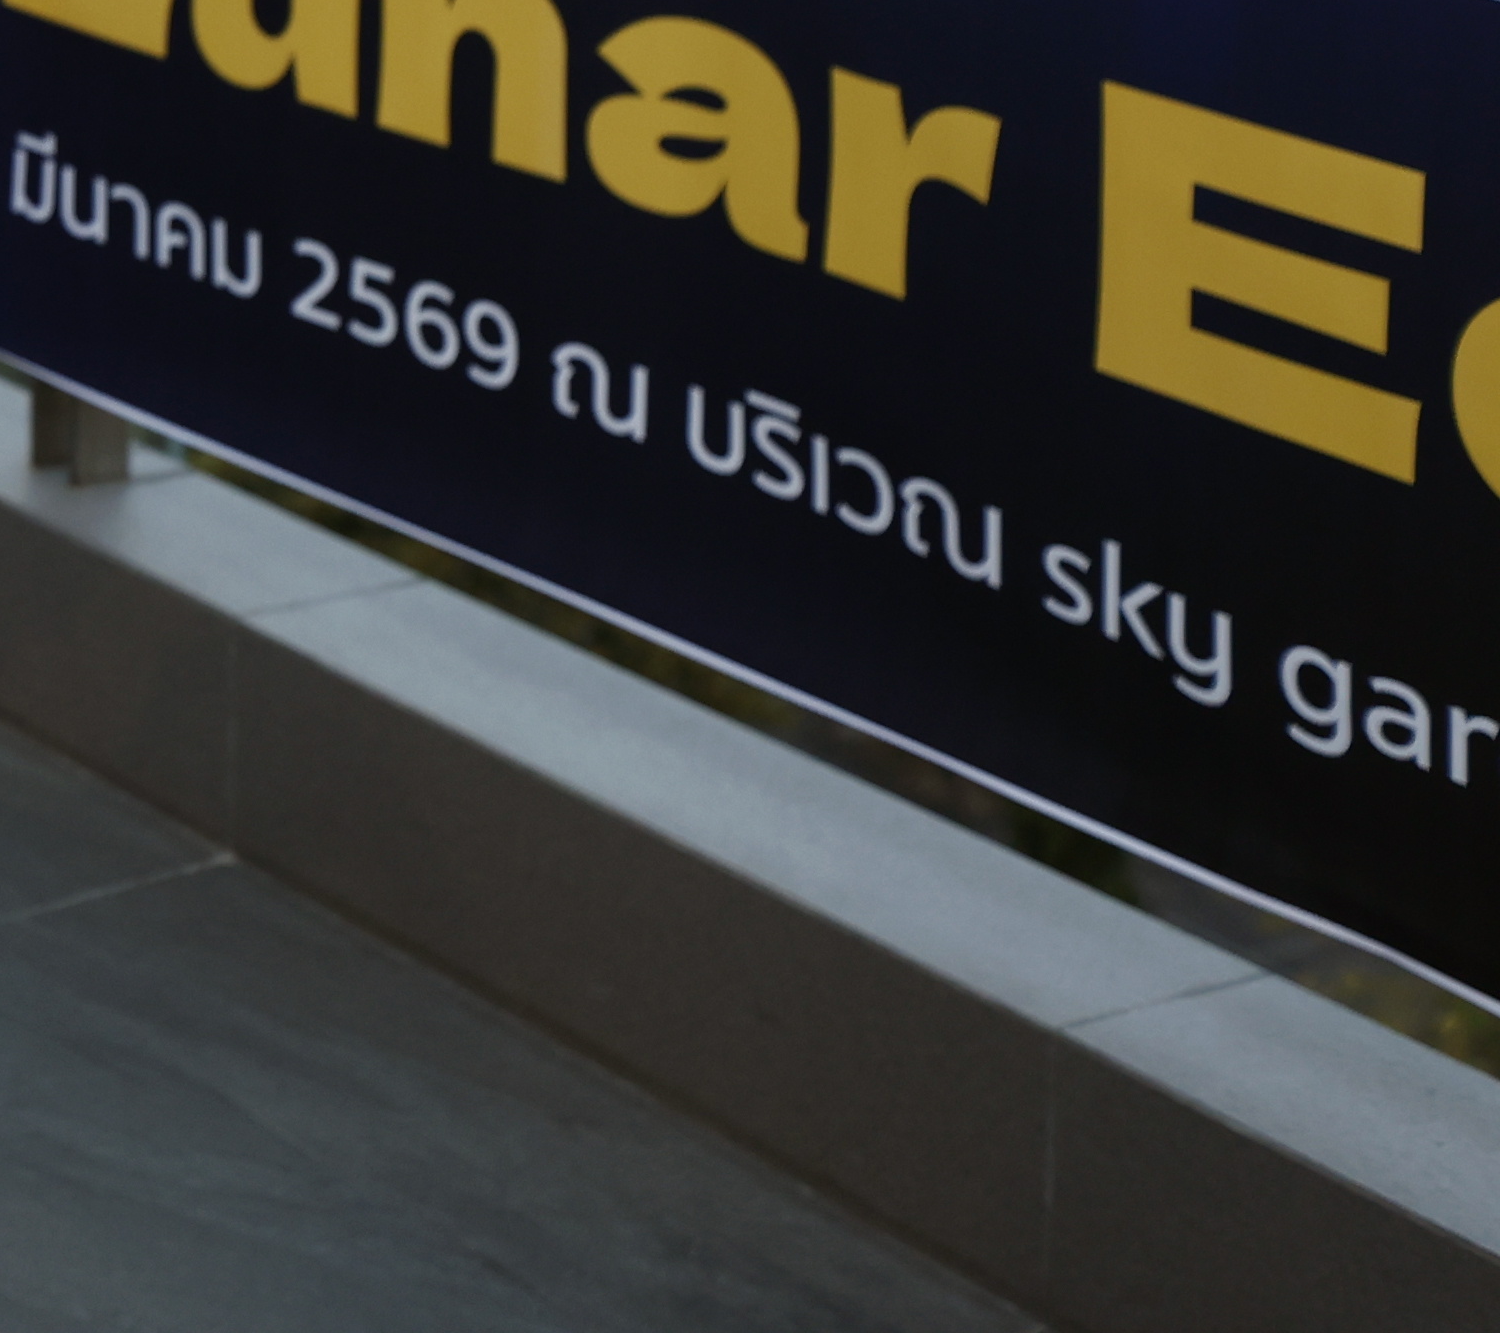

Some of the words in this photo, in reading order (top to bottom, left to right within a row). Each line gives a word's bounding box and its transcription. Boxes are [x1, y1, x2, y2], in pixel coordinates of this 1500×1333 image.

[10, 132, 263, 298] มีนาคม
[291, 237, 520, 389] 2569
[551, 342, 650, 443] ณ
[686, 385, 1003, 589] บริเวณ
[1042, 538, 1233, 707] sky
[1280, 644, 1500, 787] gar
[1095, 79, 1500, 499] E
